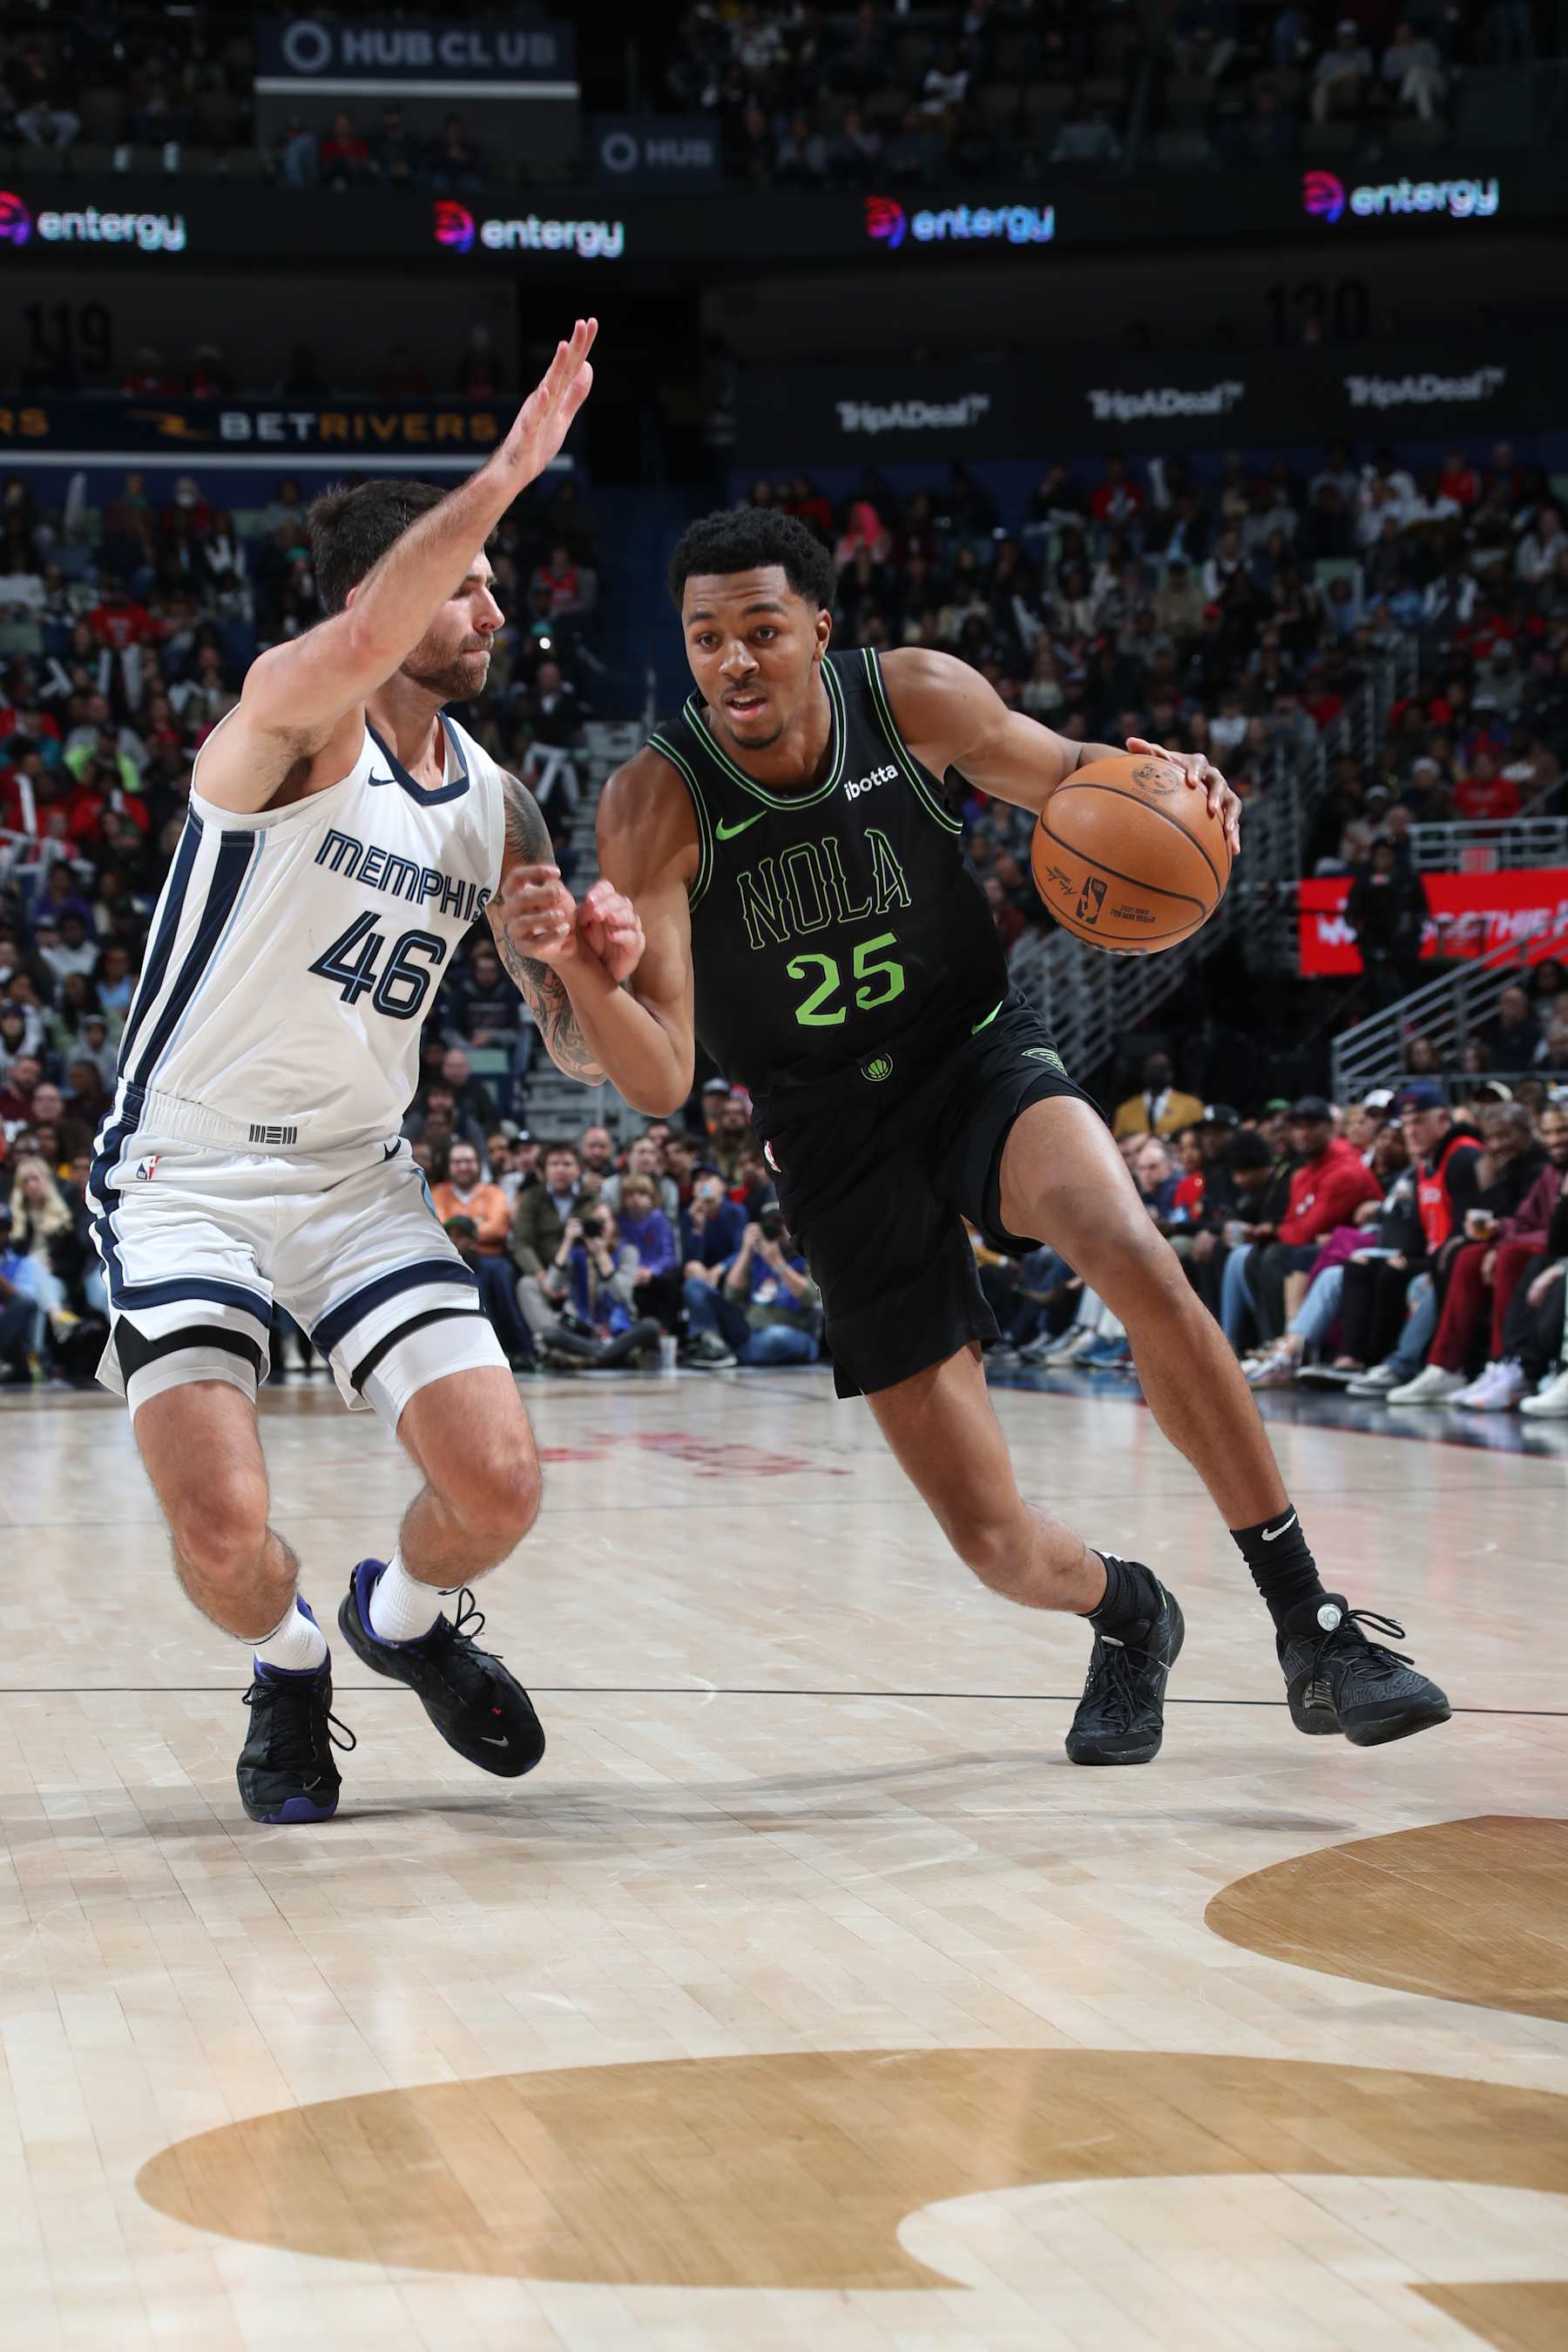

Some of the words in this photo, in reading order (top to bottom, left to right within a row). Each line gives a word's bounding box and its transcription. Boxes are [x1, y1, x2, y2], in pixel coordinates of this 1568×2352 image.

[341, 30, 432, 64] HUB
[438, 30, 557, 66] CLUB
[645, 138, 712, 166] HUB
[1349, 178, 1500, 218] entergy
[37, 208, 186, 252] entergy
[481, 216, 625, 259] entergy
[911, 204, 1055, 245] entergy
[24, 301, 112, 375] 119
[220, 412, 500, 443] BETRIVERS
[843, 764, 899, 802] ibotta
[314, 828, 492, 923] MEMPHIS
[737, 829, 911, 950] NOLA
[308, 910, 447, 1020] 46
[786, 932, 905, 1026] 25
